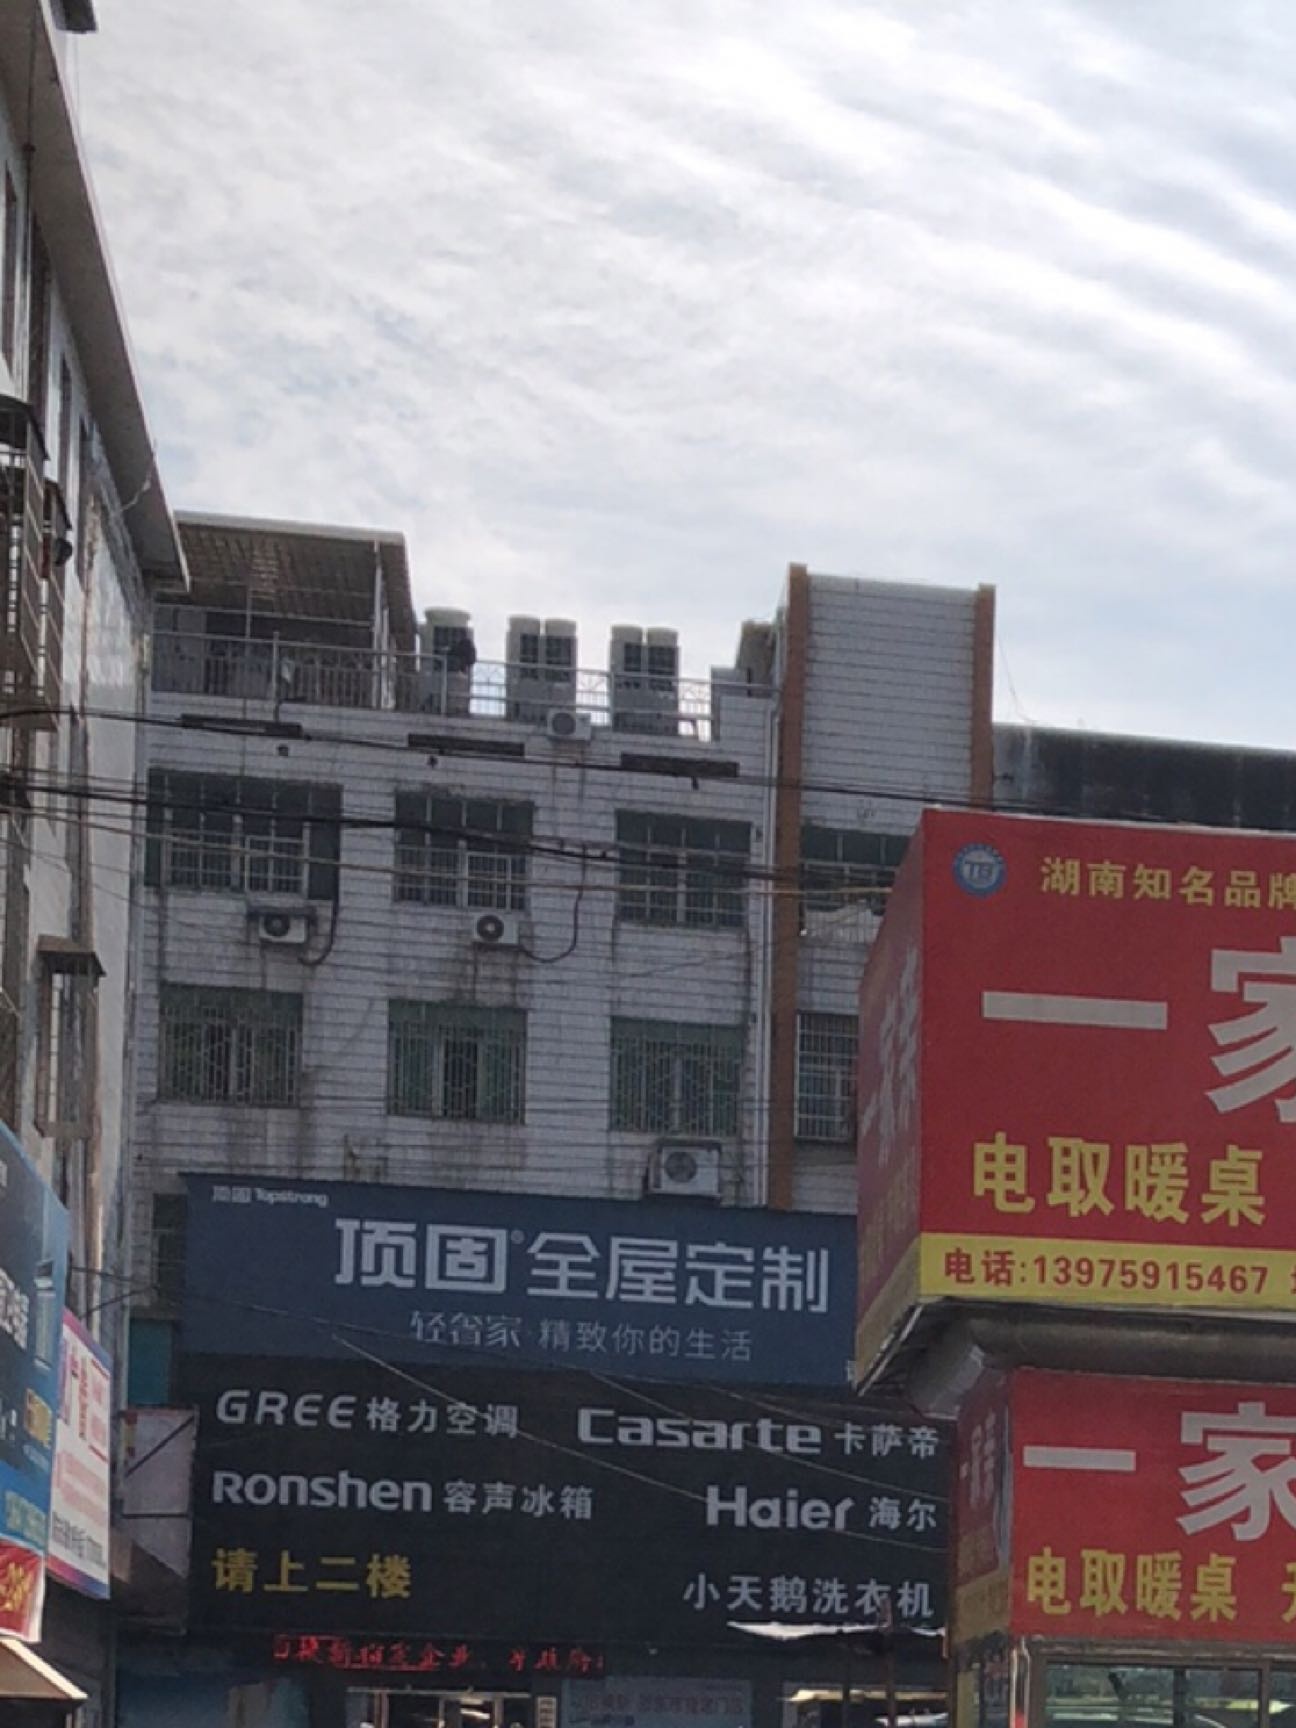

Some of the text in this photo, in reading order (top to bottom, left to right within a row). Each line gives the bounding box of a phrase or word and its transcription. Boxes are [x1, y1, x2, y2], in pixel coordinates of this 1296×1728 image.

[972, 1131, 1265, 1228] 电取暖桌
[944, 1247, 1270, 1295] 电话:13975915467
[215, 1389, 518, 1440] GREE 格力空调
[577, 1408, 939, 1459] Casarte 卡萨帝
[213, 1471, 594, 1521] Ronshen 容声冰箱
[705, 1486, 938, 1533] Haier 海尔
[212, 1547, 412, 1599] 请上二楼
[682, 1573, 935, 1618] 小天鹅洗衣机
[1026, 1546, 1238, 1622] 电取暖桌
